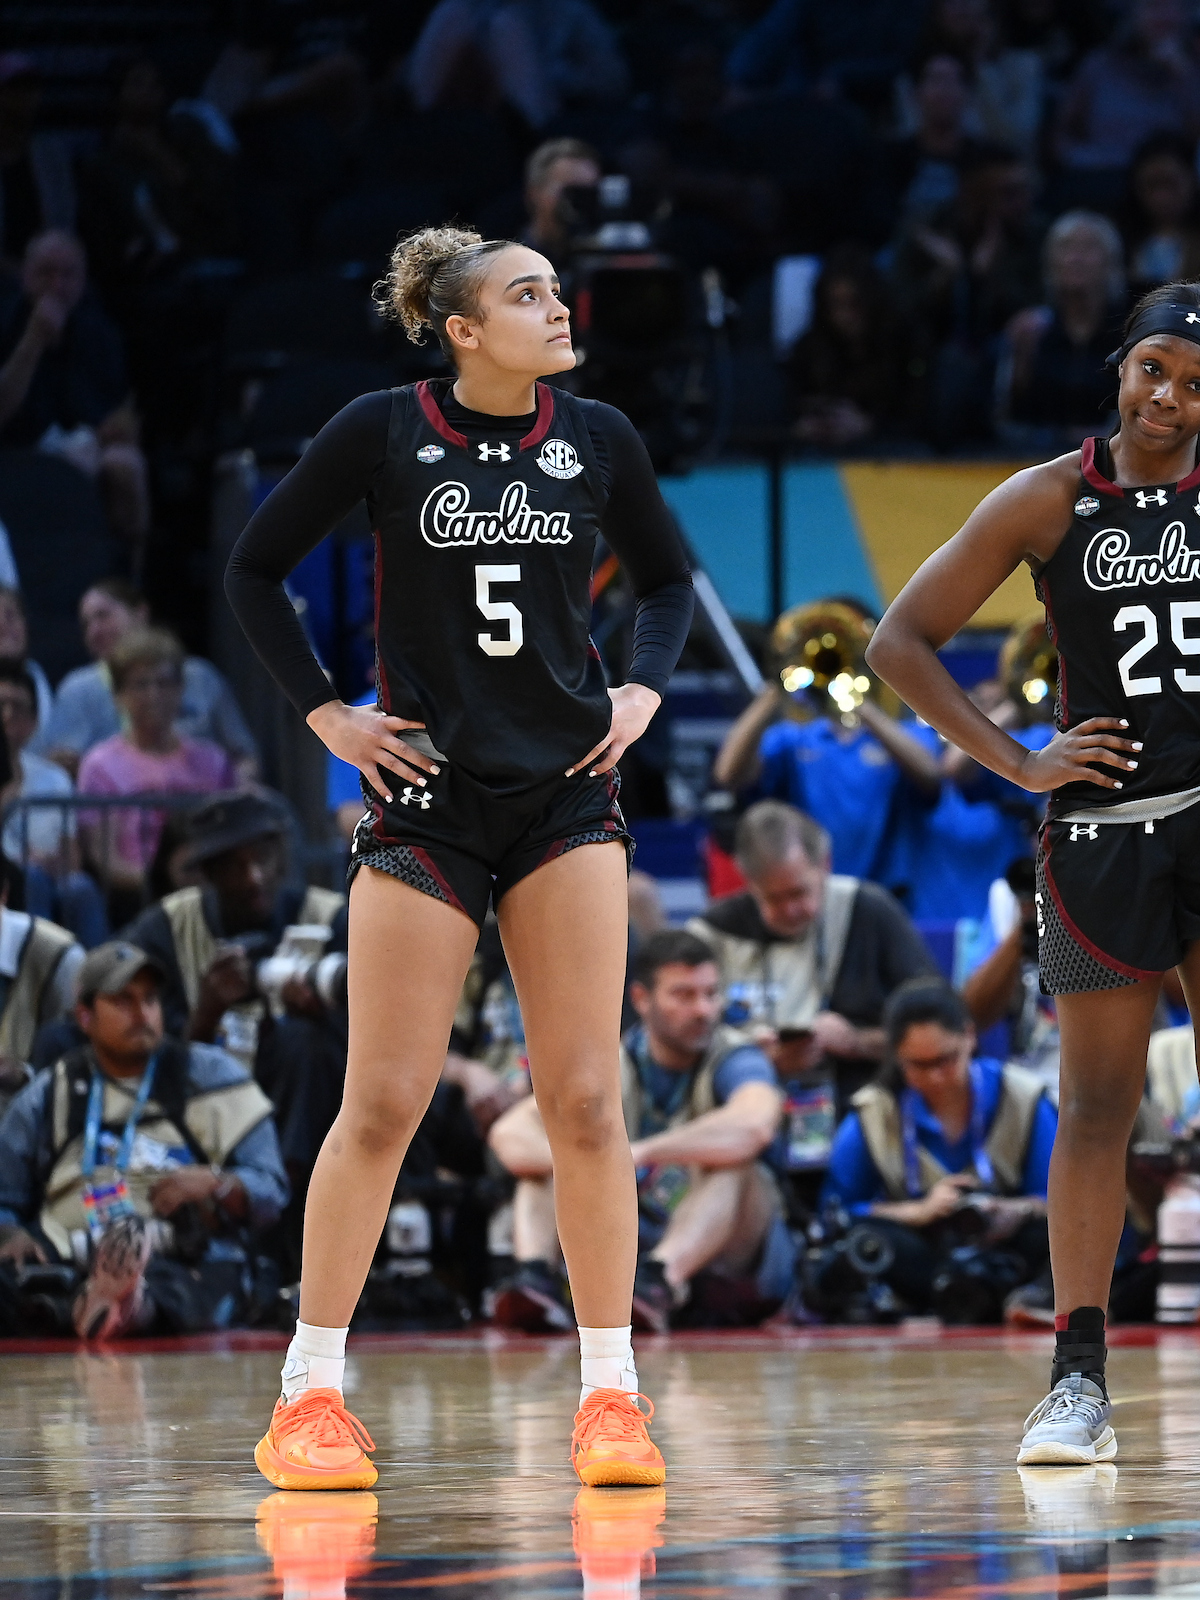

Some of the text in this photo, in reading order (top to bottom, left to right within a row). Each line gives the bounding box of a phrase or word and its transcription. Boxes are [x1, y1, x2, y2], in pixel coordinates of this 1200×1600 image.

[540, 463, 578, 479] GRADUATE
[544, 440, 575, 469] SEC
[420, 480, 574, 548] Carolina
[474, 564, 524, 657] 5
